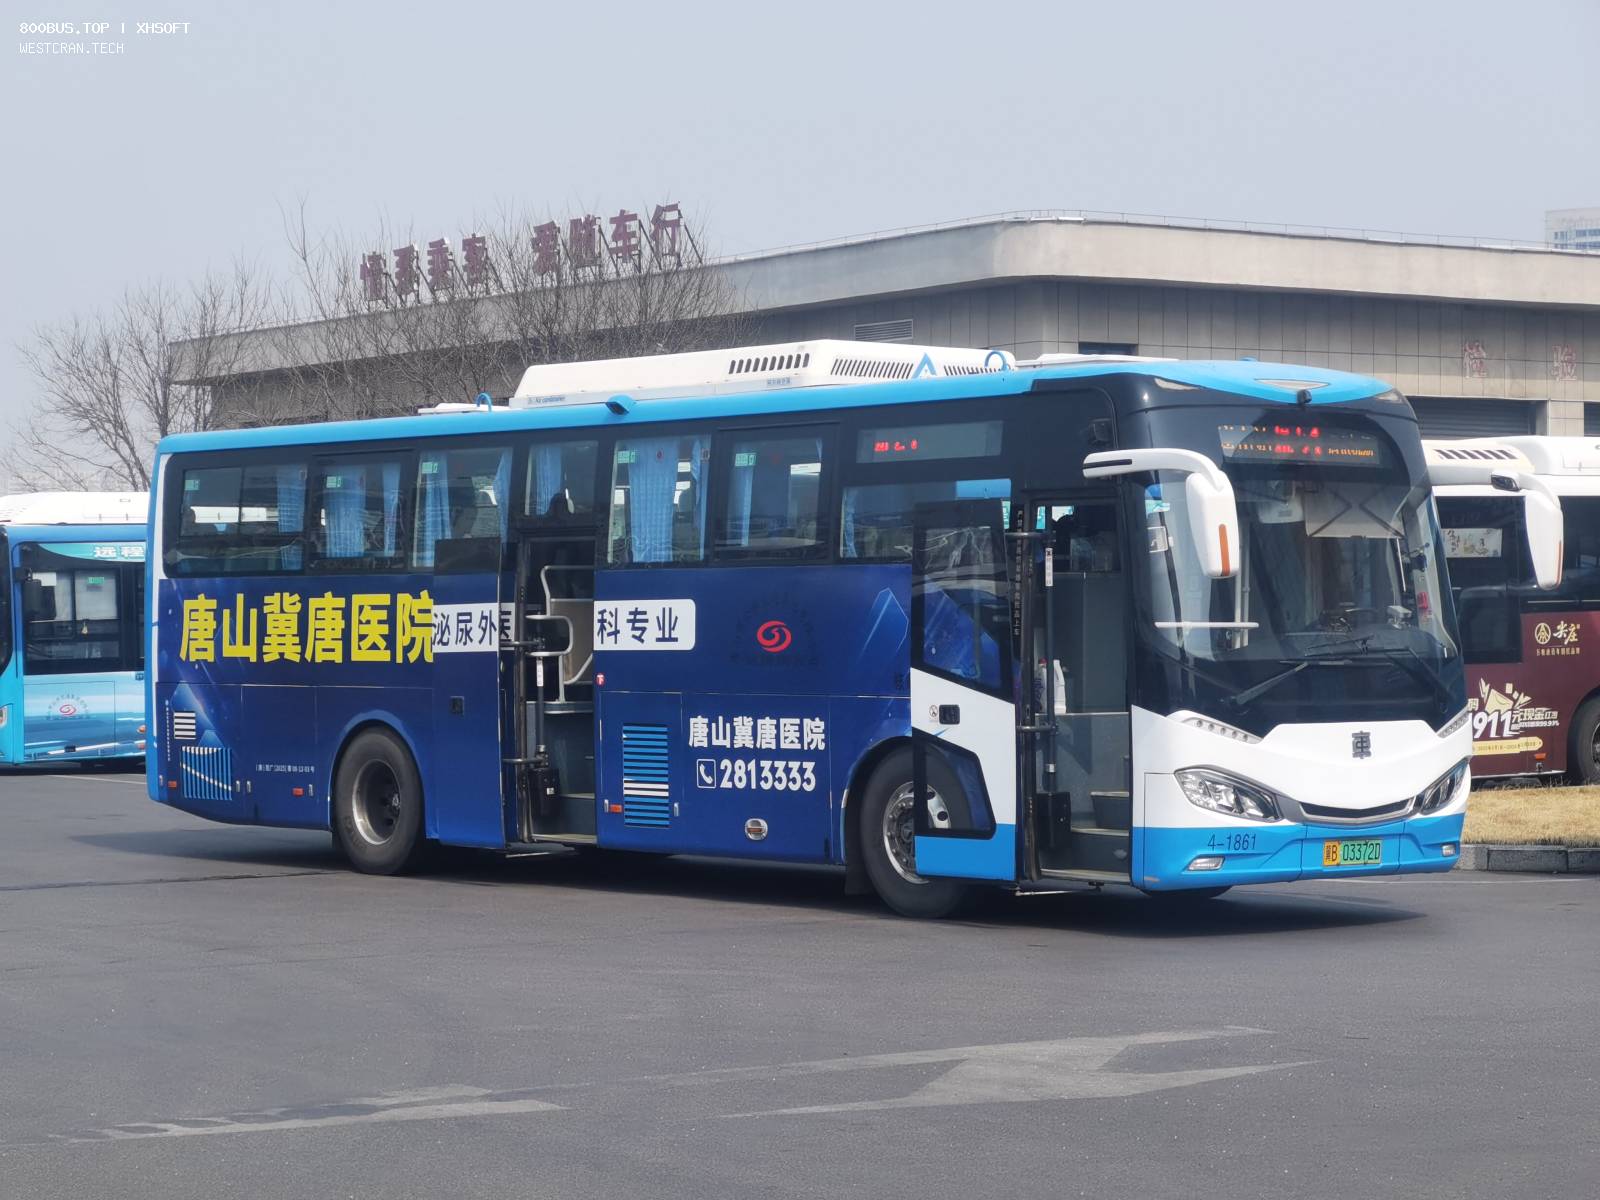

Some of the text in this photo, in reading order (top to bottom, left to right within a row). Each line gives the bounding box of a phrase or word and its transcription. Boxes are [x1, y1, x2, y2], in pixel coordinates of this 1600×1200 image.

[179, 590, 434, 664] 唐山冀唐医院
[689, 715, 826, 750] 唐山冀唐医院
[720, 759, 817, 792] 2813333
[1207, 833, 1256, 851] 4-1861
